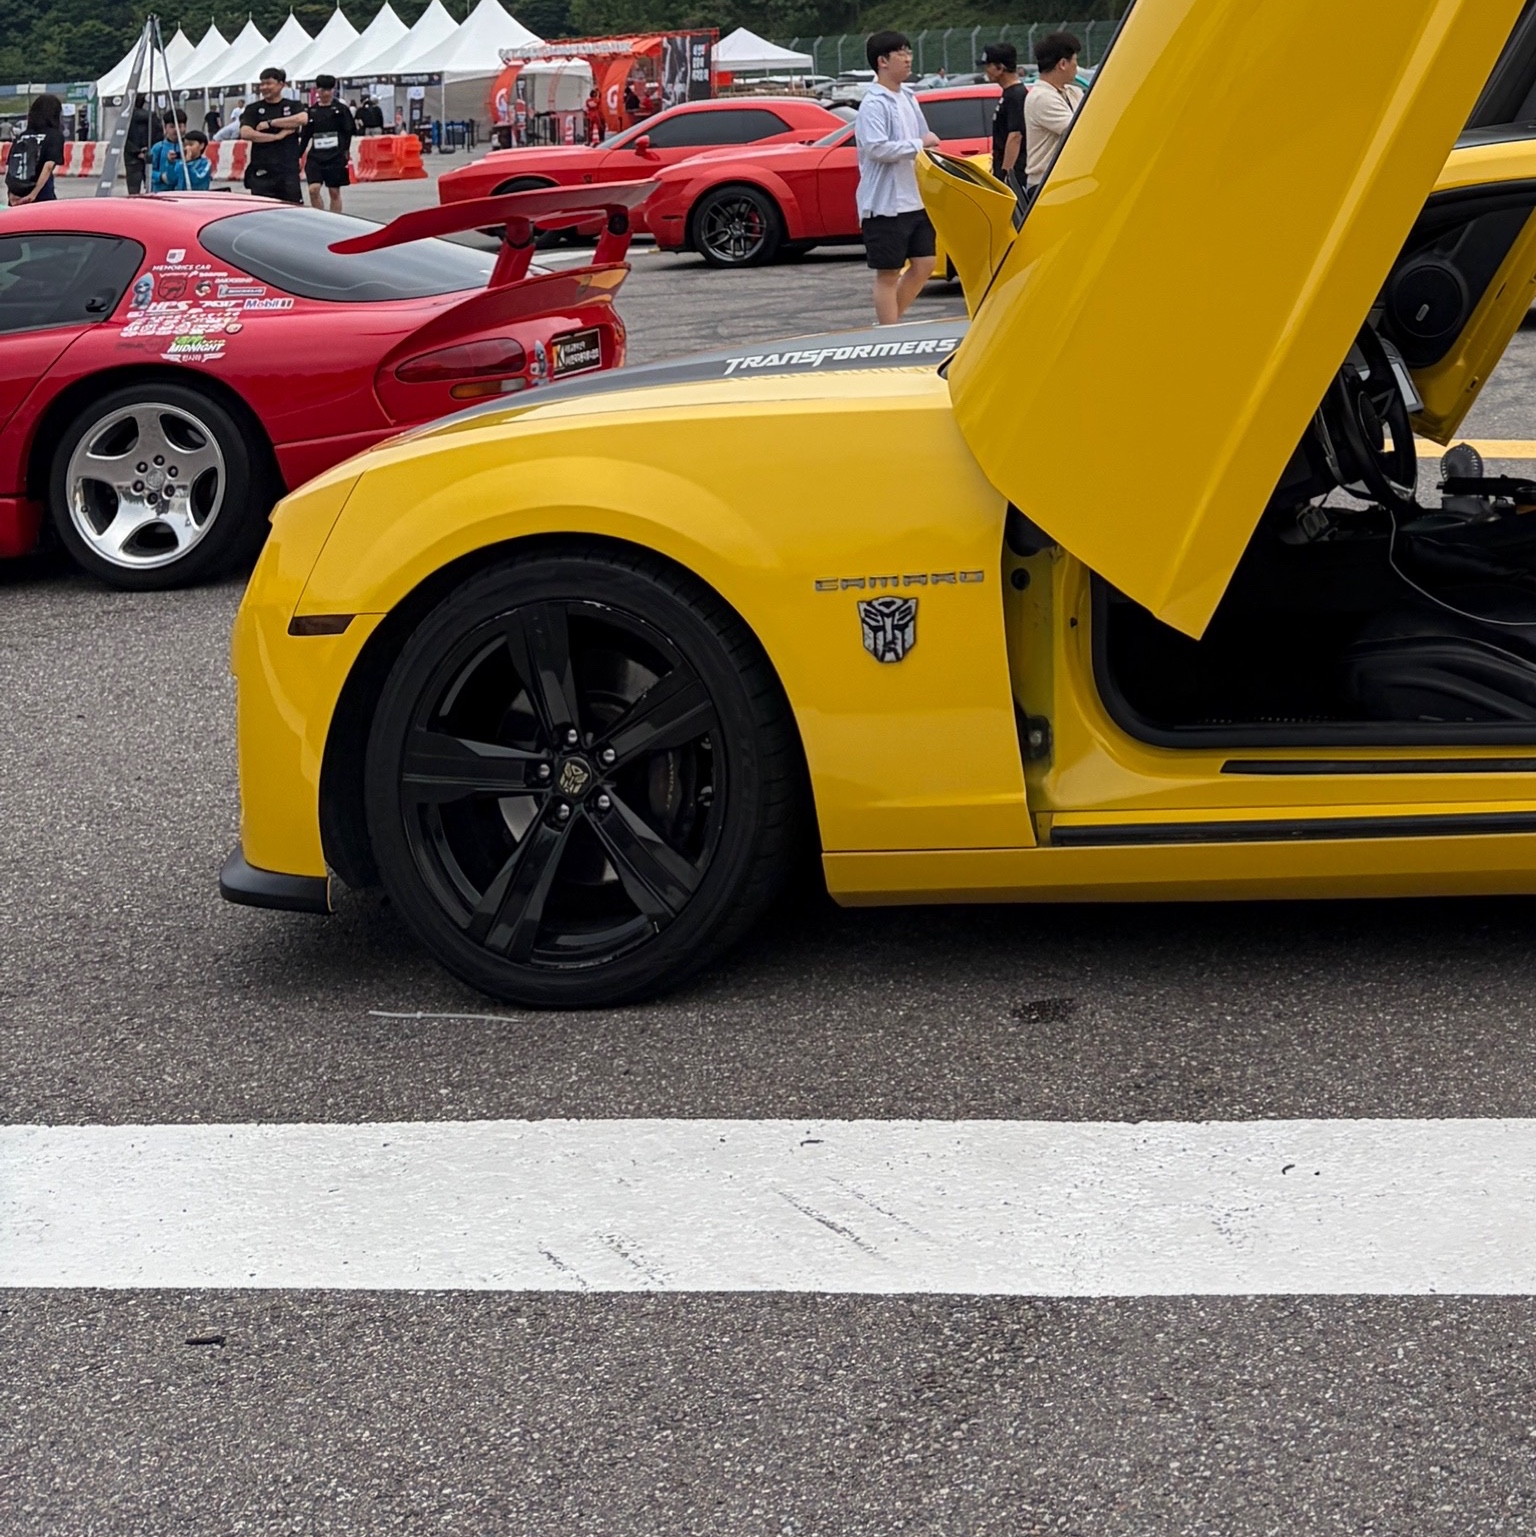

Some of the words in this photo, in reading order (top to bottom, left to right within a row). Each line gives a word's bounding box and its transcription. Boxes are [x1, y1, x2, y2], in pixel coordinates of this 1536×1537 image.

[246, 300, 279, 308] Mobil
[167, 341, 226, 353] MIDNIGHT
[723, 339, 958, 375] TRANSFORMERS
[815, 570, 984, 591] CAMARO
